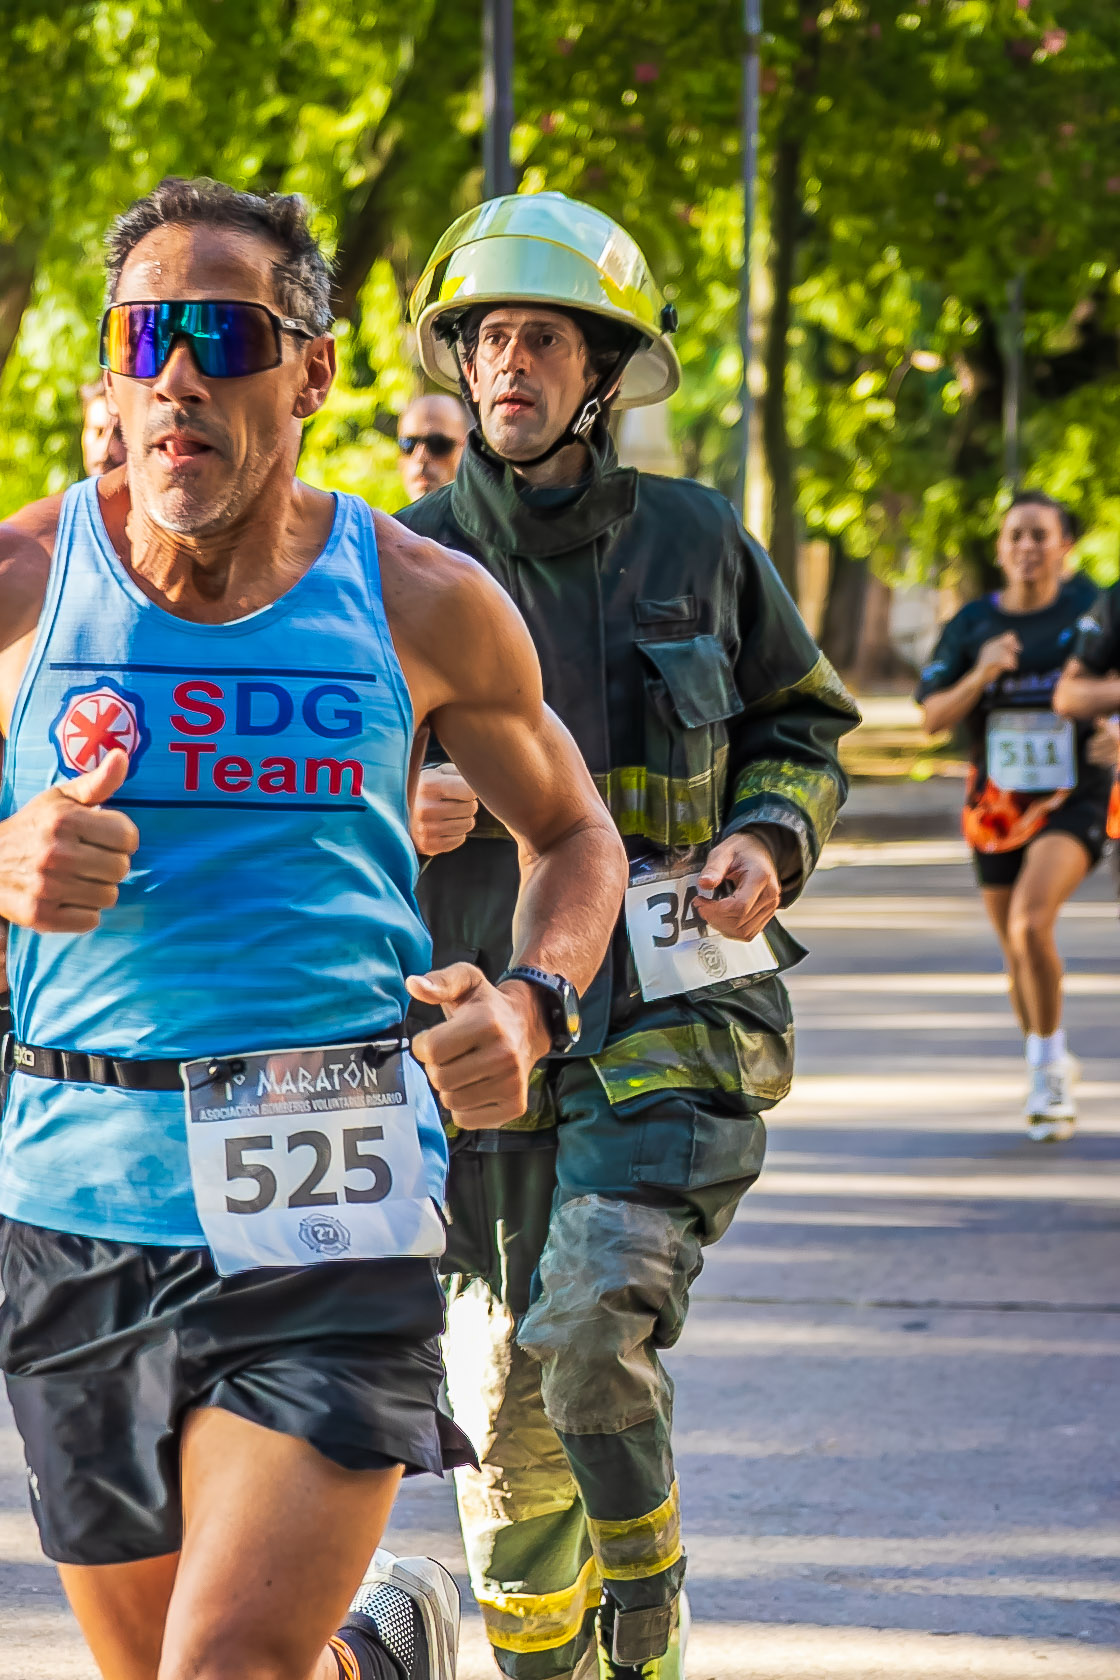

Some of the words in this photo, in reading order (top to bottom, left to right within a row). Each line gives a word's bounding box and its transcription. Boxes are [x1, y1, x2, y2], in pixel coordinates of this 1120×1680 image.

[169, 680, 364, 739] SDG
[168, 742, 365, 797] Team
[646, 886, 709, 948] 34
[257, 1053, 379, 1096] MARATÓN
[225, 1126, 393, 1215] 525
[313, 1226, 335, 1241] 27
